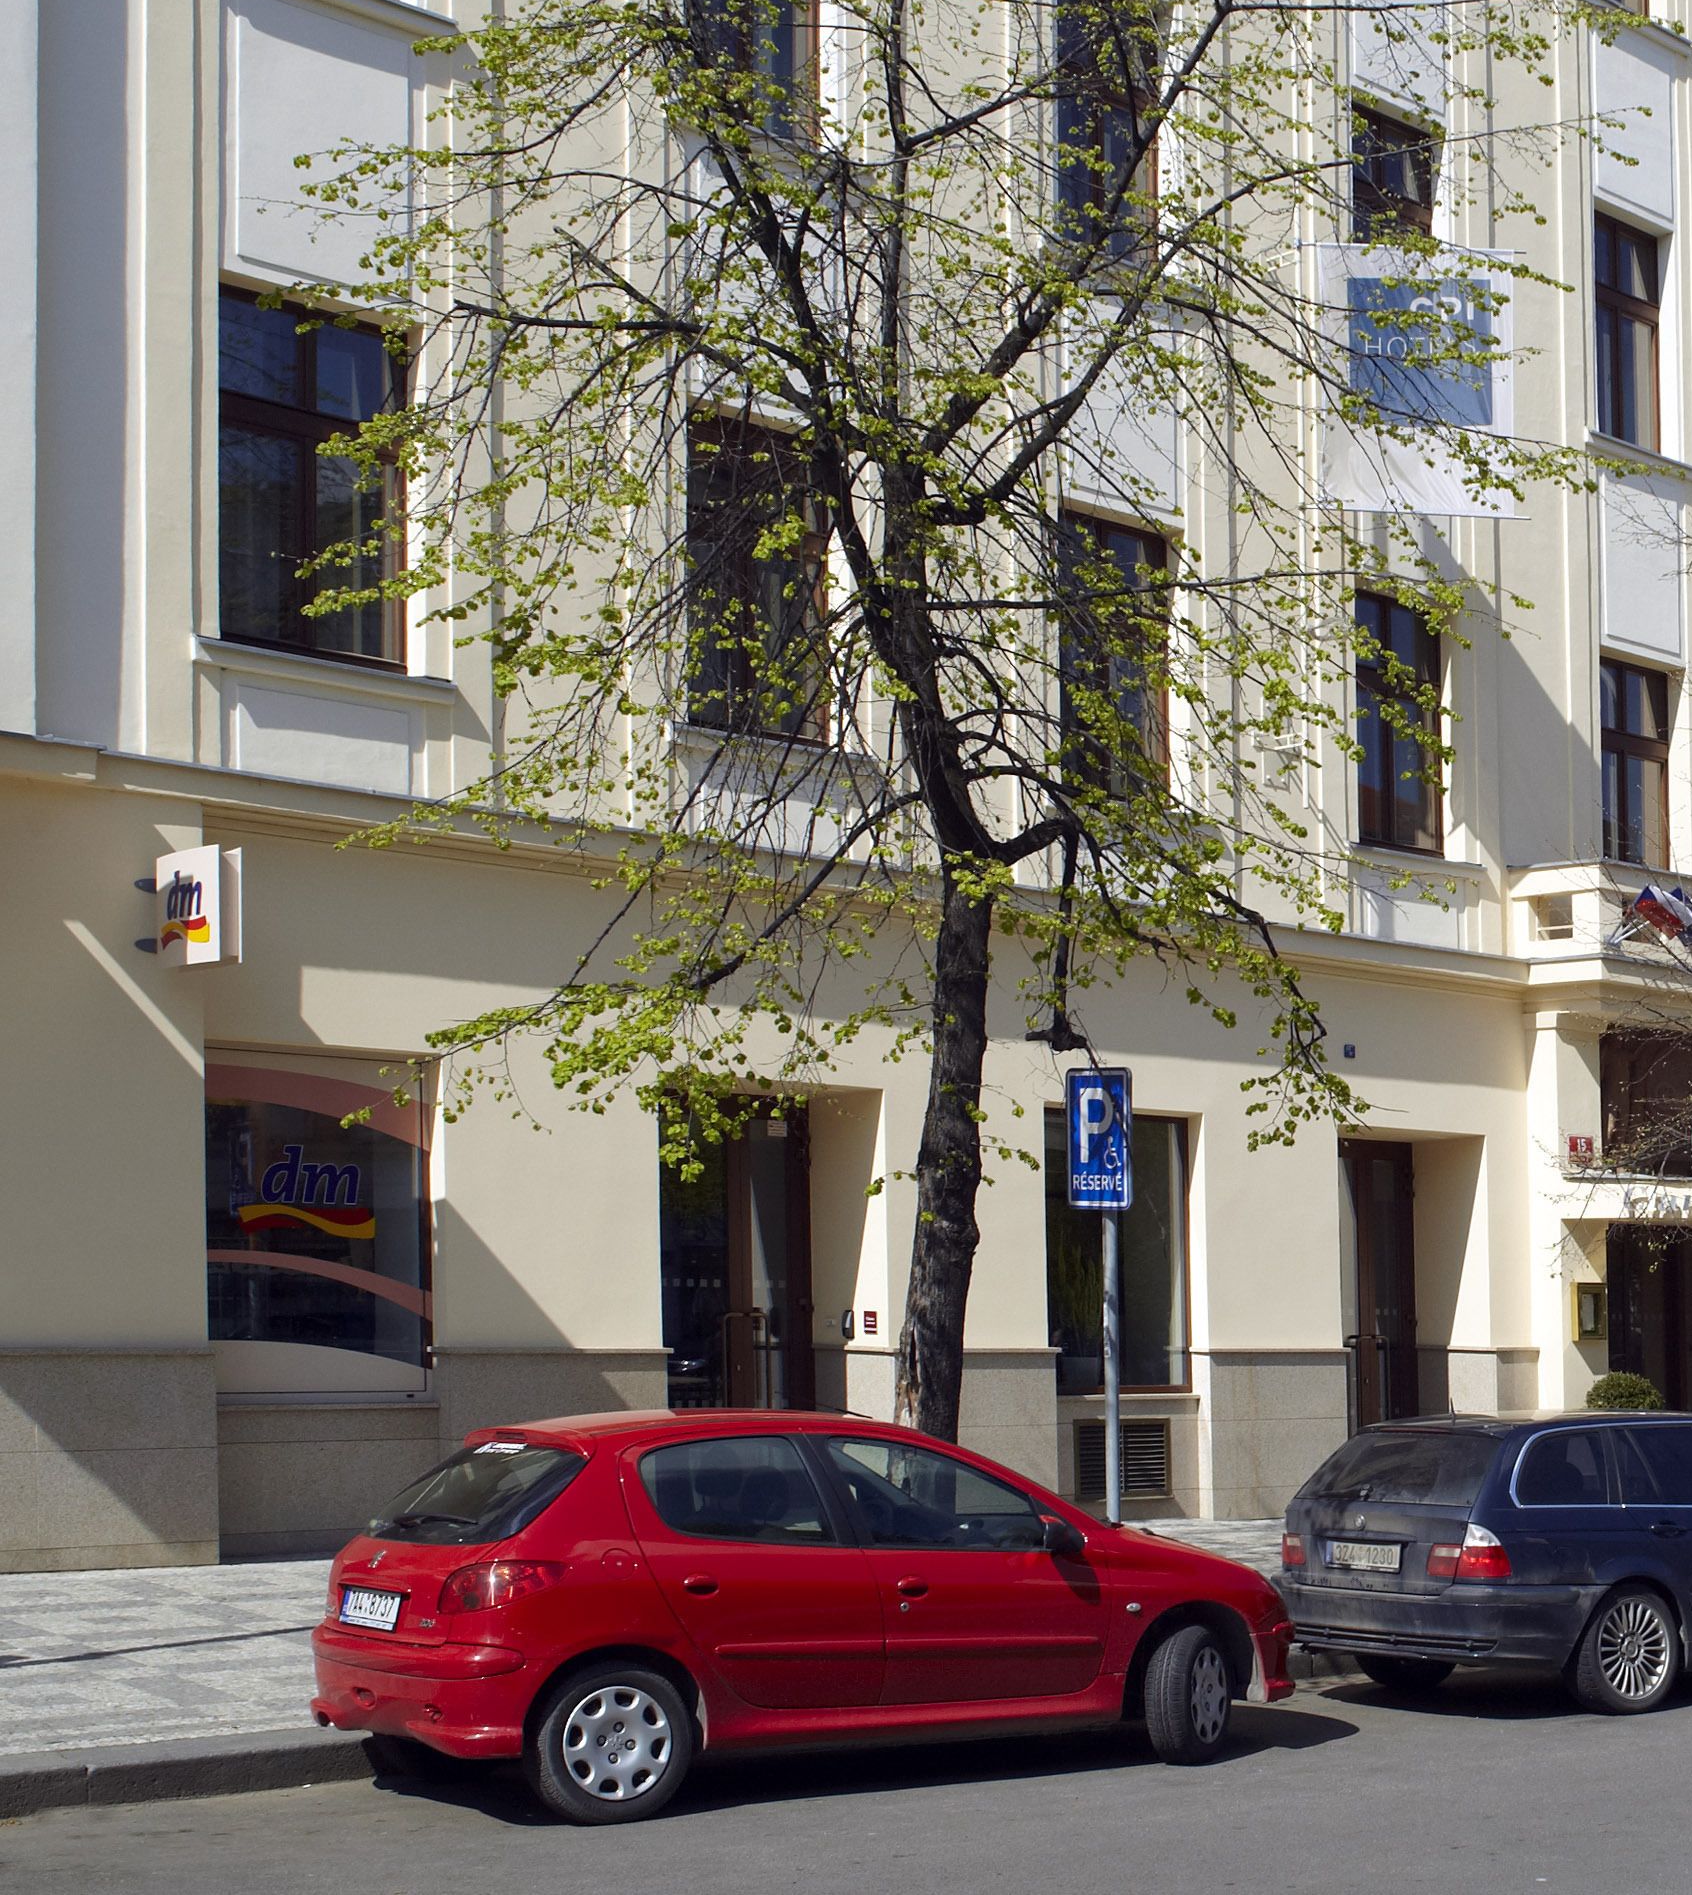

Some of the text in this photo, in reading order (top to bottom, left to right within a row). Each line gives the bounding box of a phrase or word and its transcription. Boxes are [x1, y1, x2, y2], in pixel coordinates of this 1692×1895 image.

[167, 870, 203, 921] dm
[261, 1144, 361, 1206] dm
[1072, 1170, 1123, 1192] RÉSERVÉ
[1366, 1547, 1394, 1565] 1230
